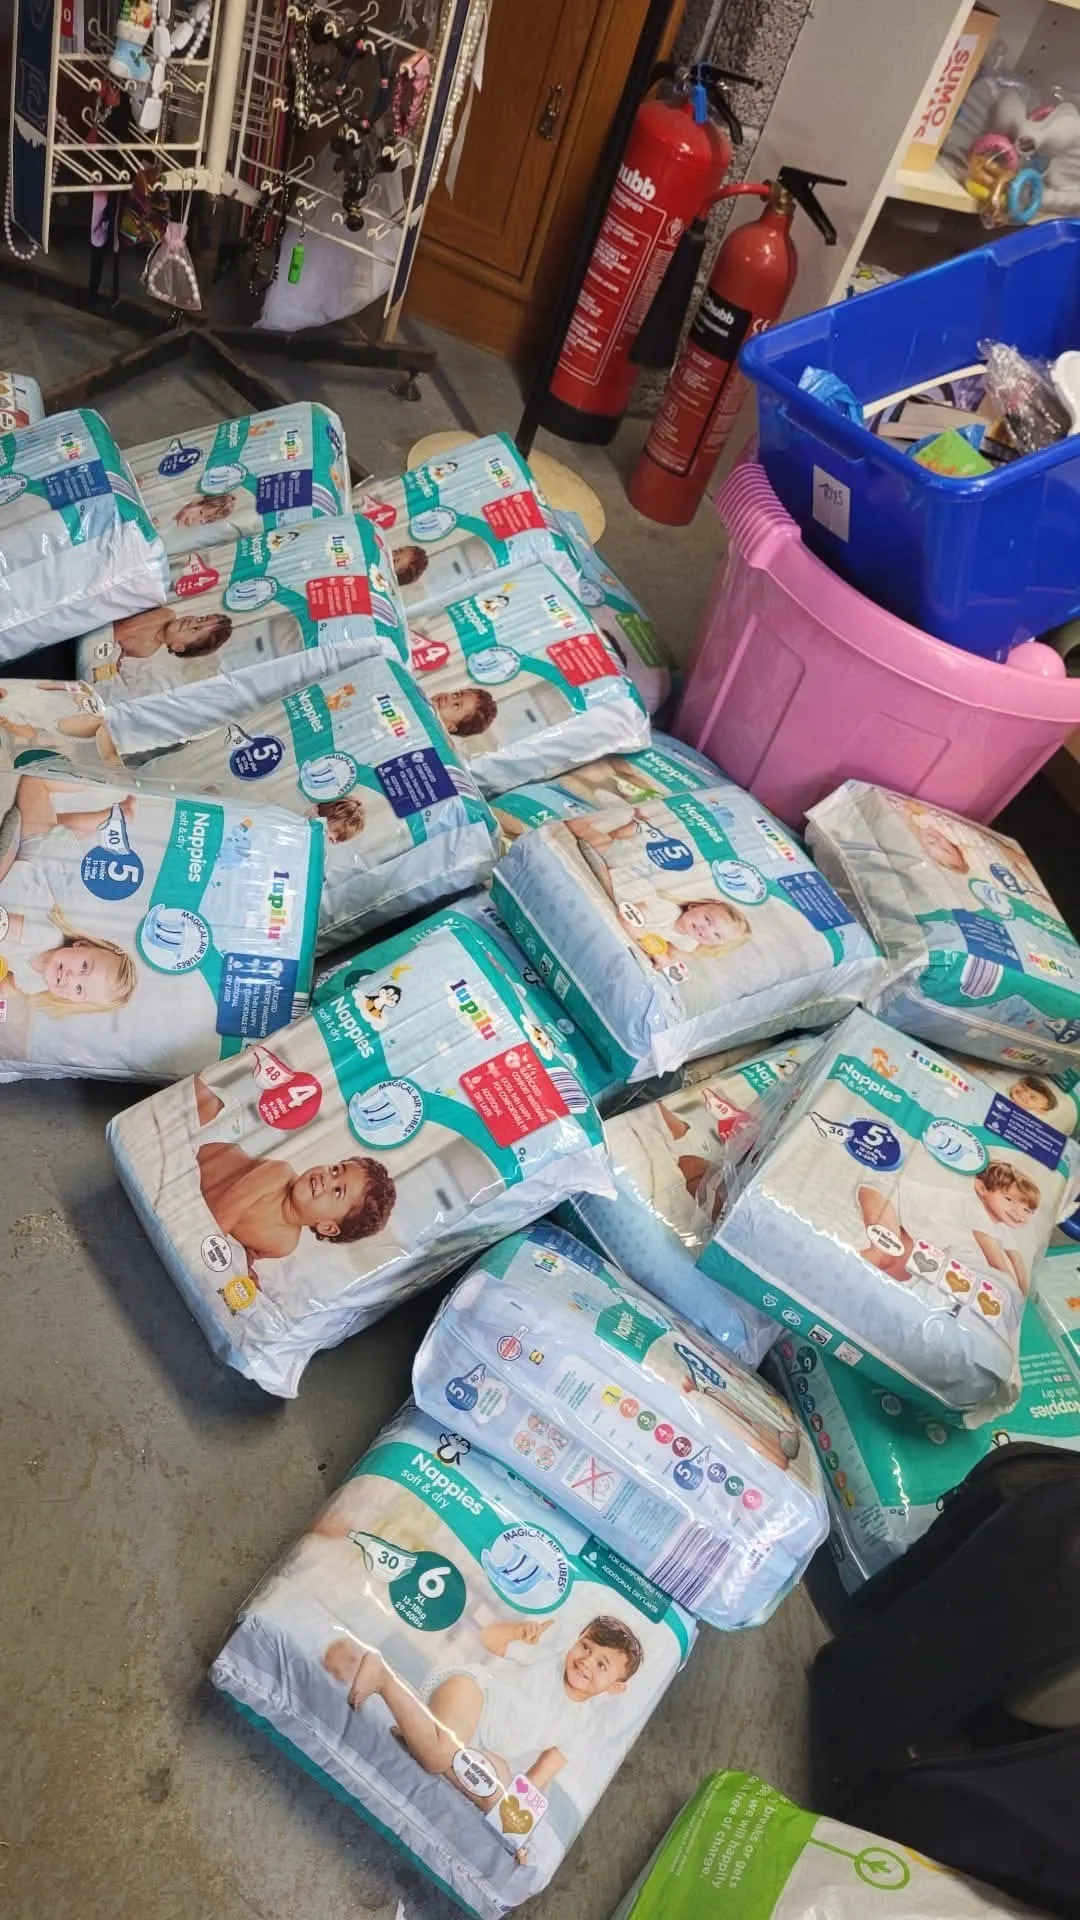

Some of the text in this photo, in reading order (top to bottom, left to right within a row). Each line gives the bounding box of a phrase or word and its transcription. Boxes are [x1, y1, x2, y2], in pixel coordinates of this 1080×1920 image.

[932, 50, 969, 126] SUMO
[426, 646, 447, 662] 4
[375, 693, 408, 738] lupilu
[108, 829, 121, 845] 40
[679, 803, 724, 844] Nappies
[174, 835, 186, 848] dry
[188, 811, 212, 883] Nappies
[665, 846, 690, 859] 5
[108, 860, 139, 884] 5
[267, 870, 291, 940] lupilu
[181, 911, 208, 940] MAGICAL
[449, 978, 497, 1041] lupilu
[316, 1008, 342, 1043] soft & dry
[331, 996, 375, 1059] Nappies
[265, 1065, 281, 1081] 48
[838, 1061, 903, 1103] Nappies
[910, 1049, 973, 1093] lupilu
[287, 1085, 318, 1109] 4
[379, 1080, 415, 1098] MAGICAL
[412, 1094, 421, 1108] AIR
[828, 1126, 845, 1137] 36
[448, 1382, 465, 1400] 5
[640, 1415, 650, 1425] 3
[411, 1451, 484, 1516] Nappies
[677, 1465, 691, 1480] 5
[399, 1466, 451, 1510] soft & dry
[377, 1550, 399, 1570] 30
[418, 1566, 451, 1600] 6
[414, 1592, 428, 1606] XL
[712, 1840, 738, 1889] happily
